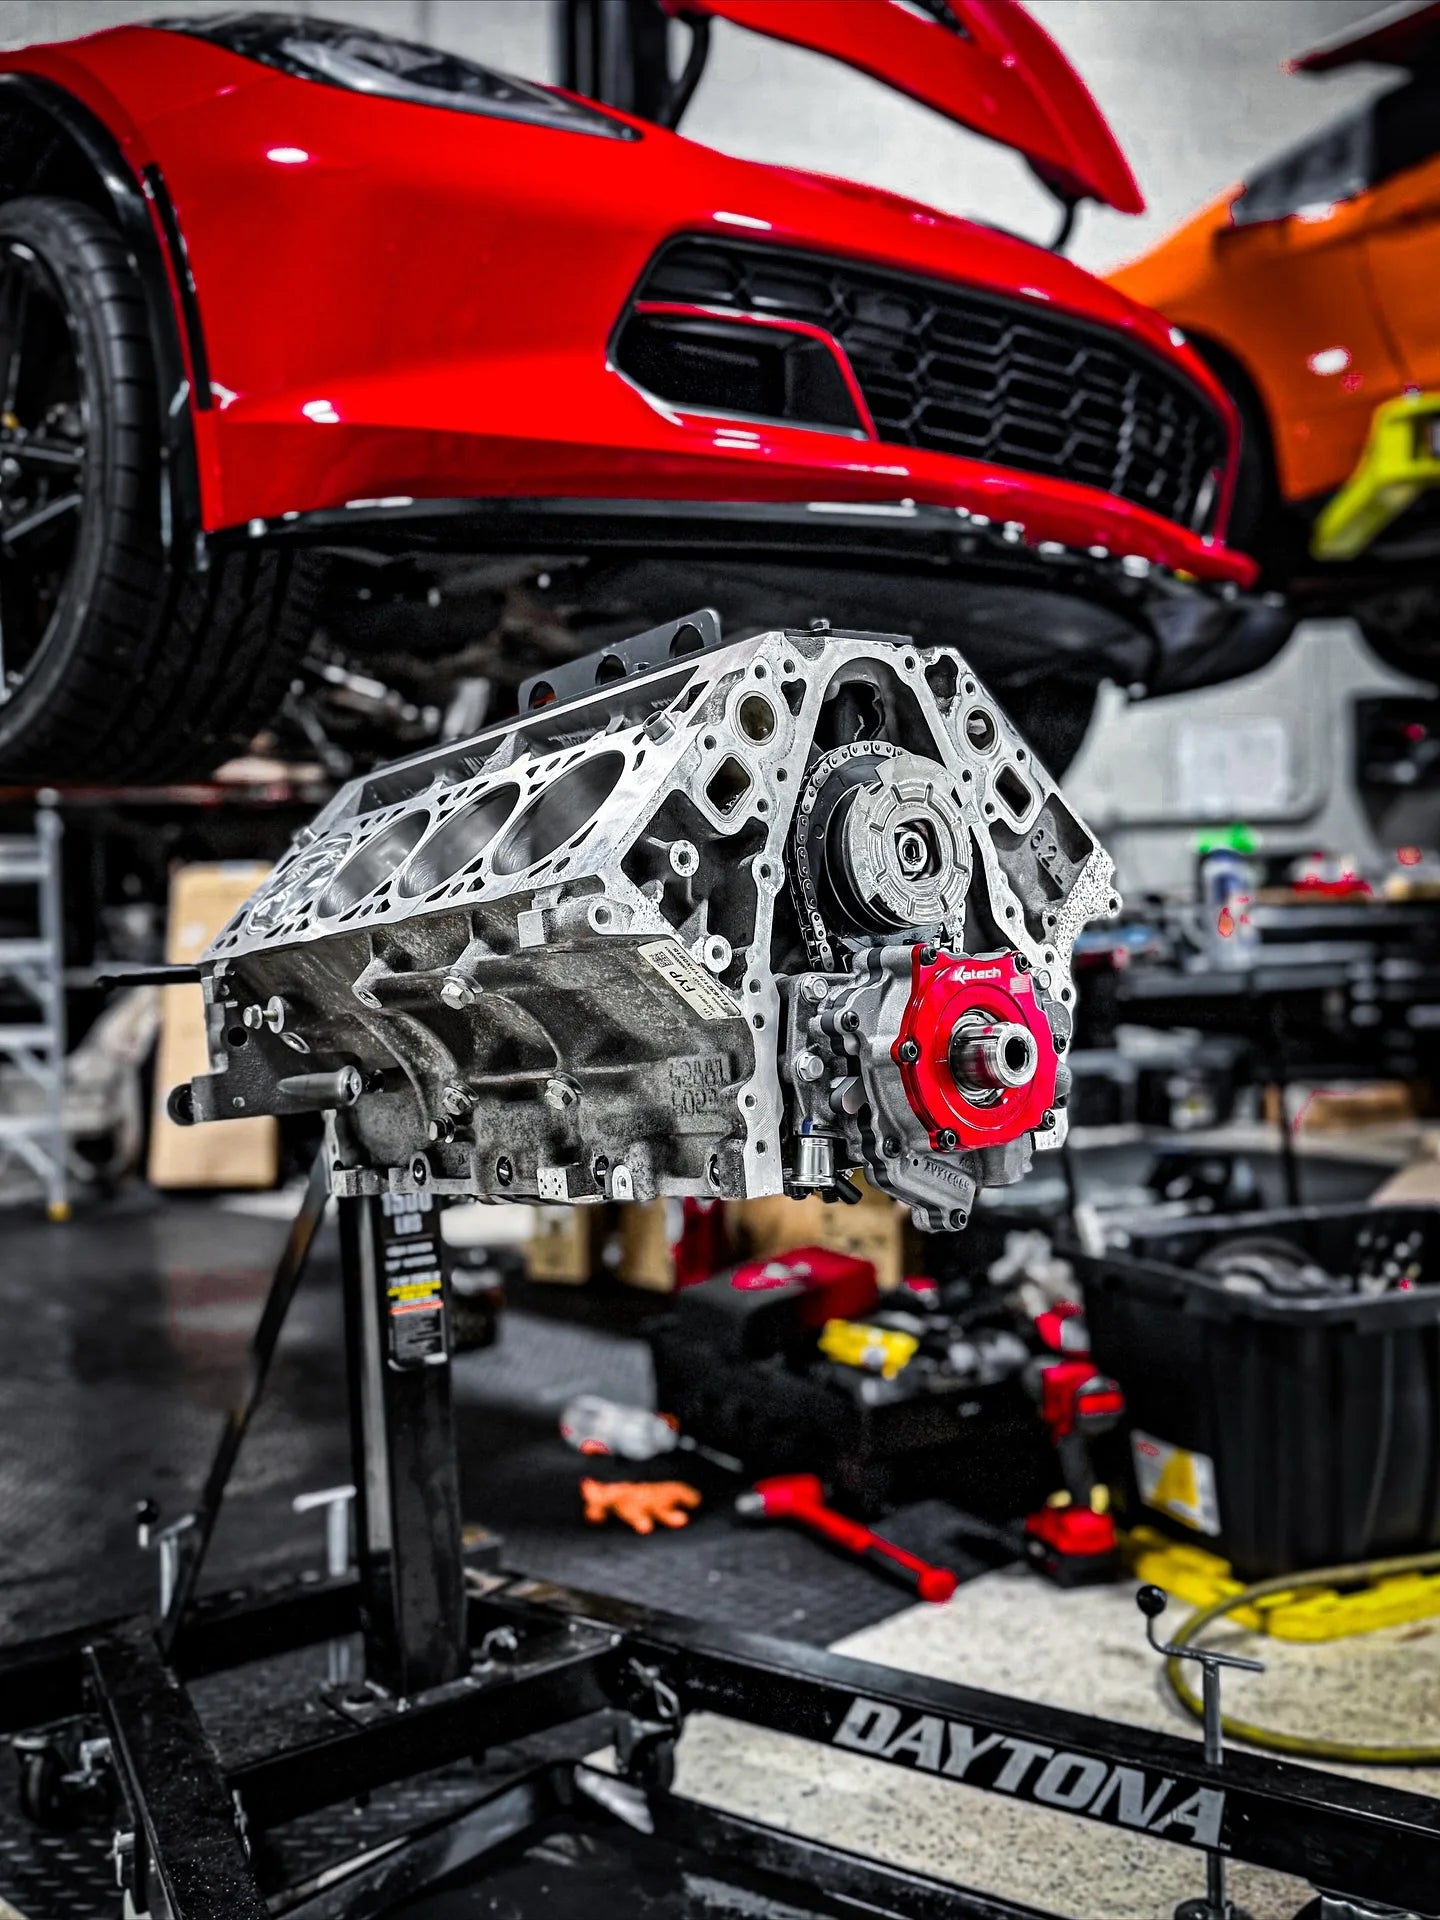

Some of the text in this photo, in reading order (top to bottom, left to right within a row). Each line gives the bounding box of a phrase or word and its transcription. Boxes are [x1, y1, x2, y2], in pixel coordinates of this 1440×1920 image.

[668, 970, 696, 993] FYP
[953, 965, 1002, 985] Katech
[832, 1696, 1226, 1848] DAYTONA
